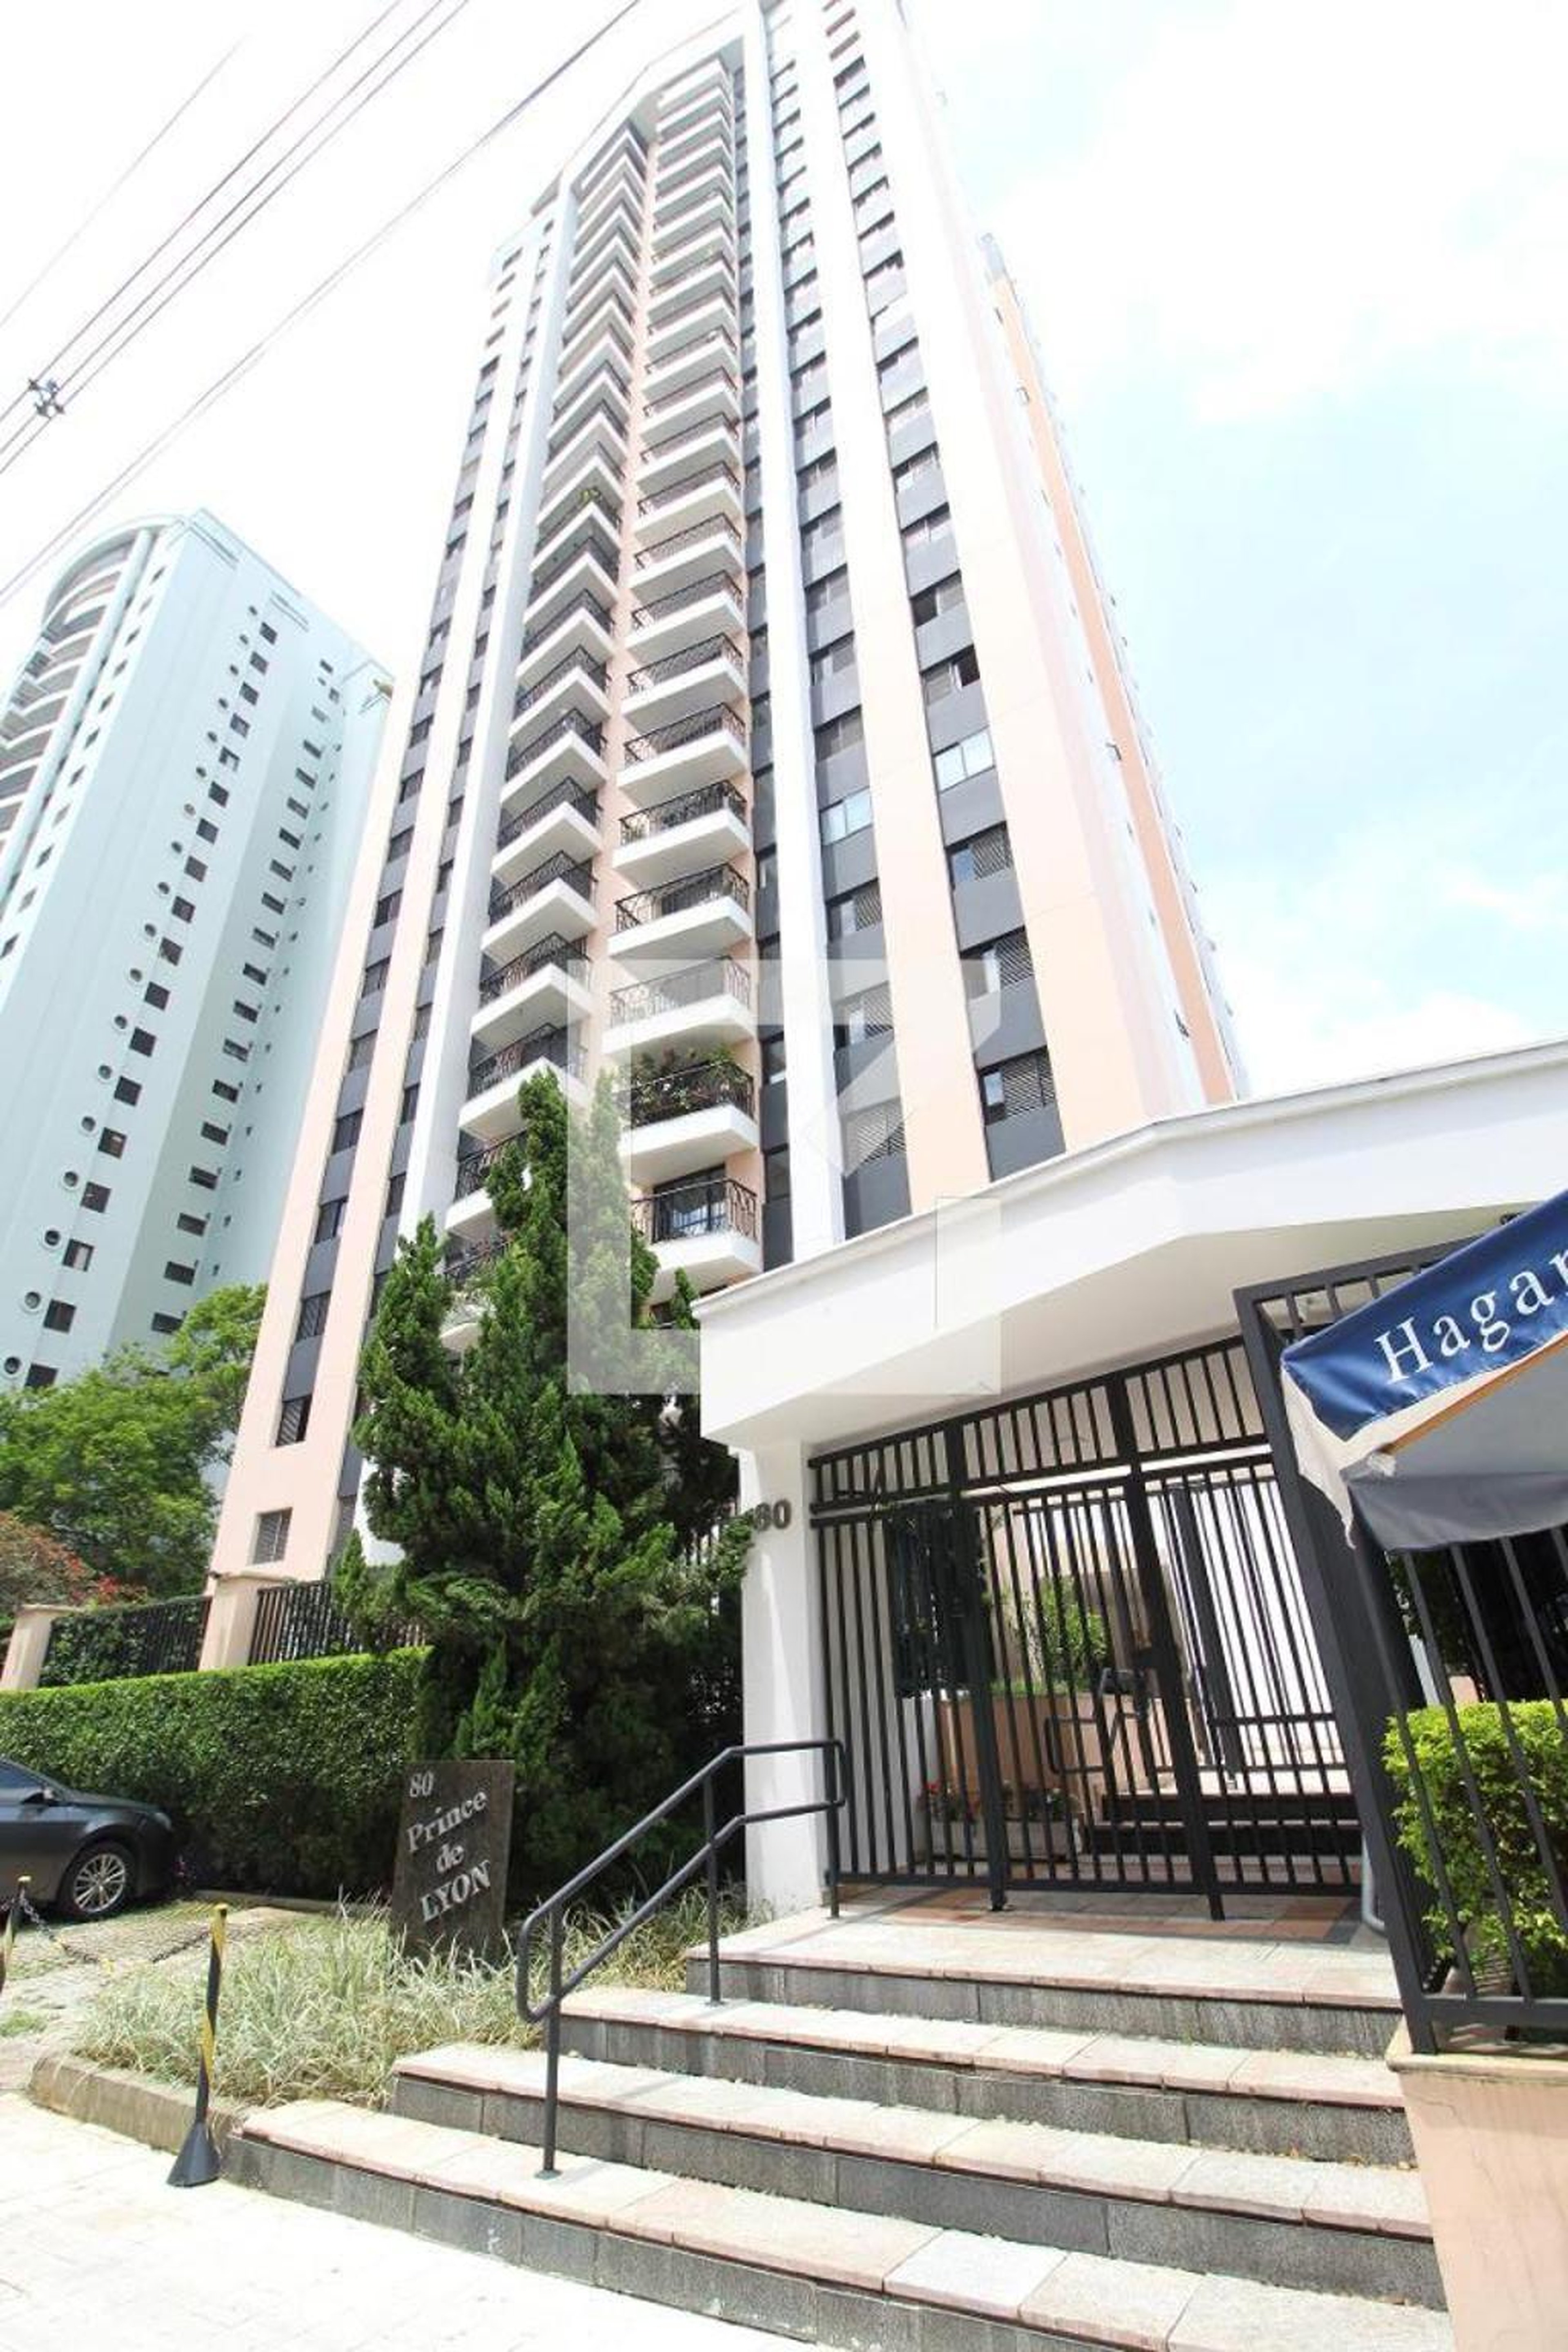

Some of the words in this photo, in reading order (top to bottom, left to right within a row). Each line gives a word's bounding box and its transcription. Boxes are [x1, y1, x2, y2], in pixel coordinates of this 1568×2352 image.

[410, 1771, 434, 1797] 80
[407, 1791, 487, 1852] Prince
[436, 1842, 465, 1873] de
[421, 1859, 490, 1921] LYON
